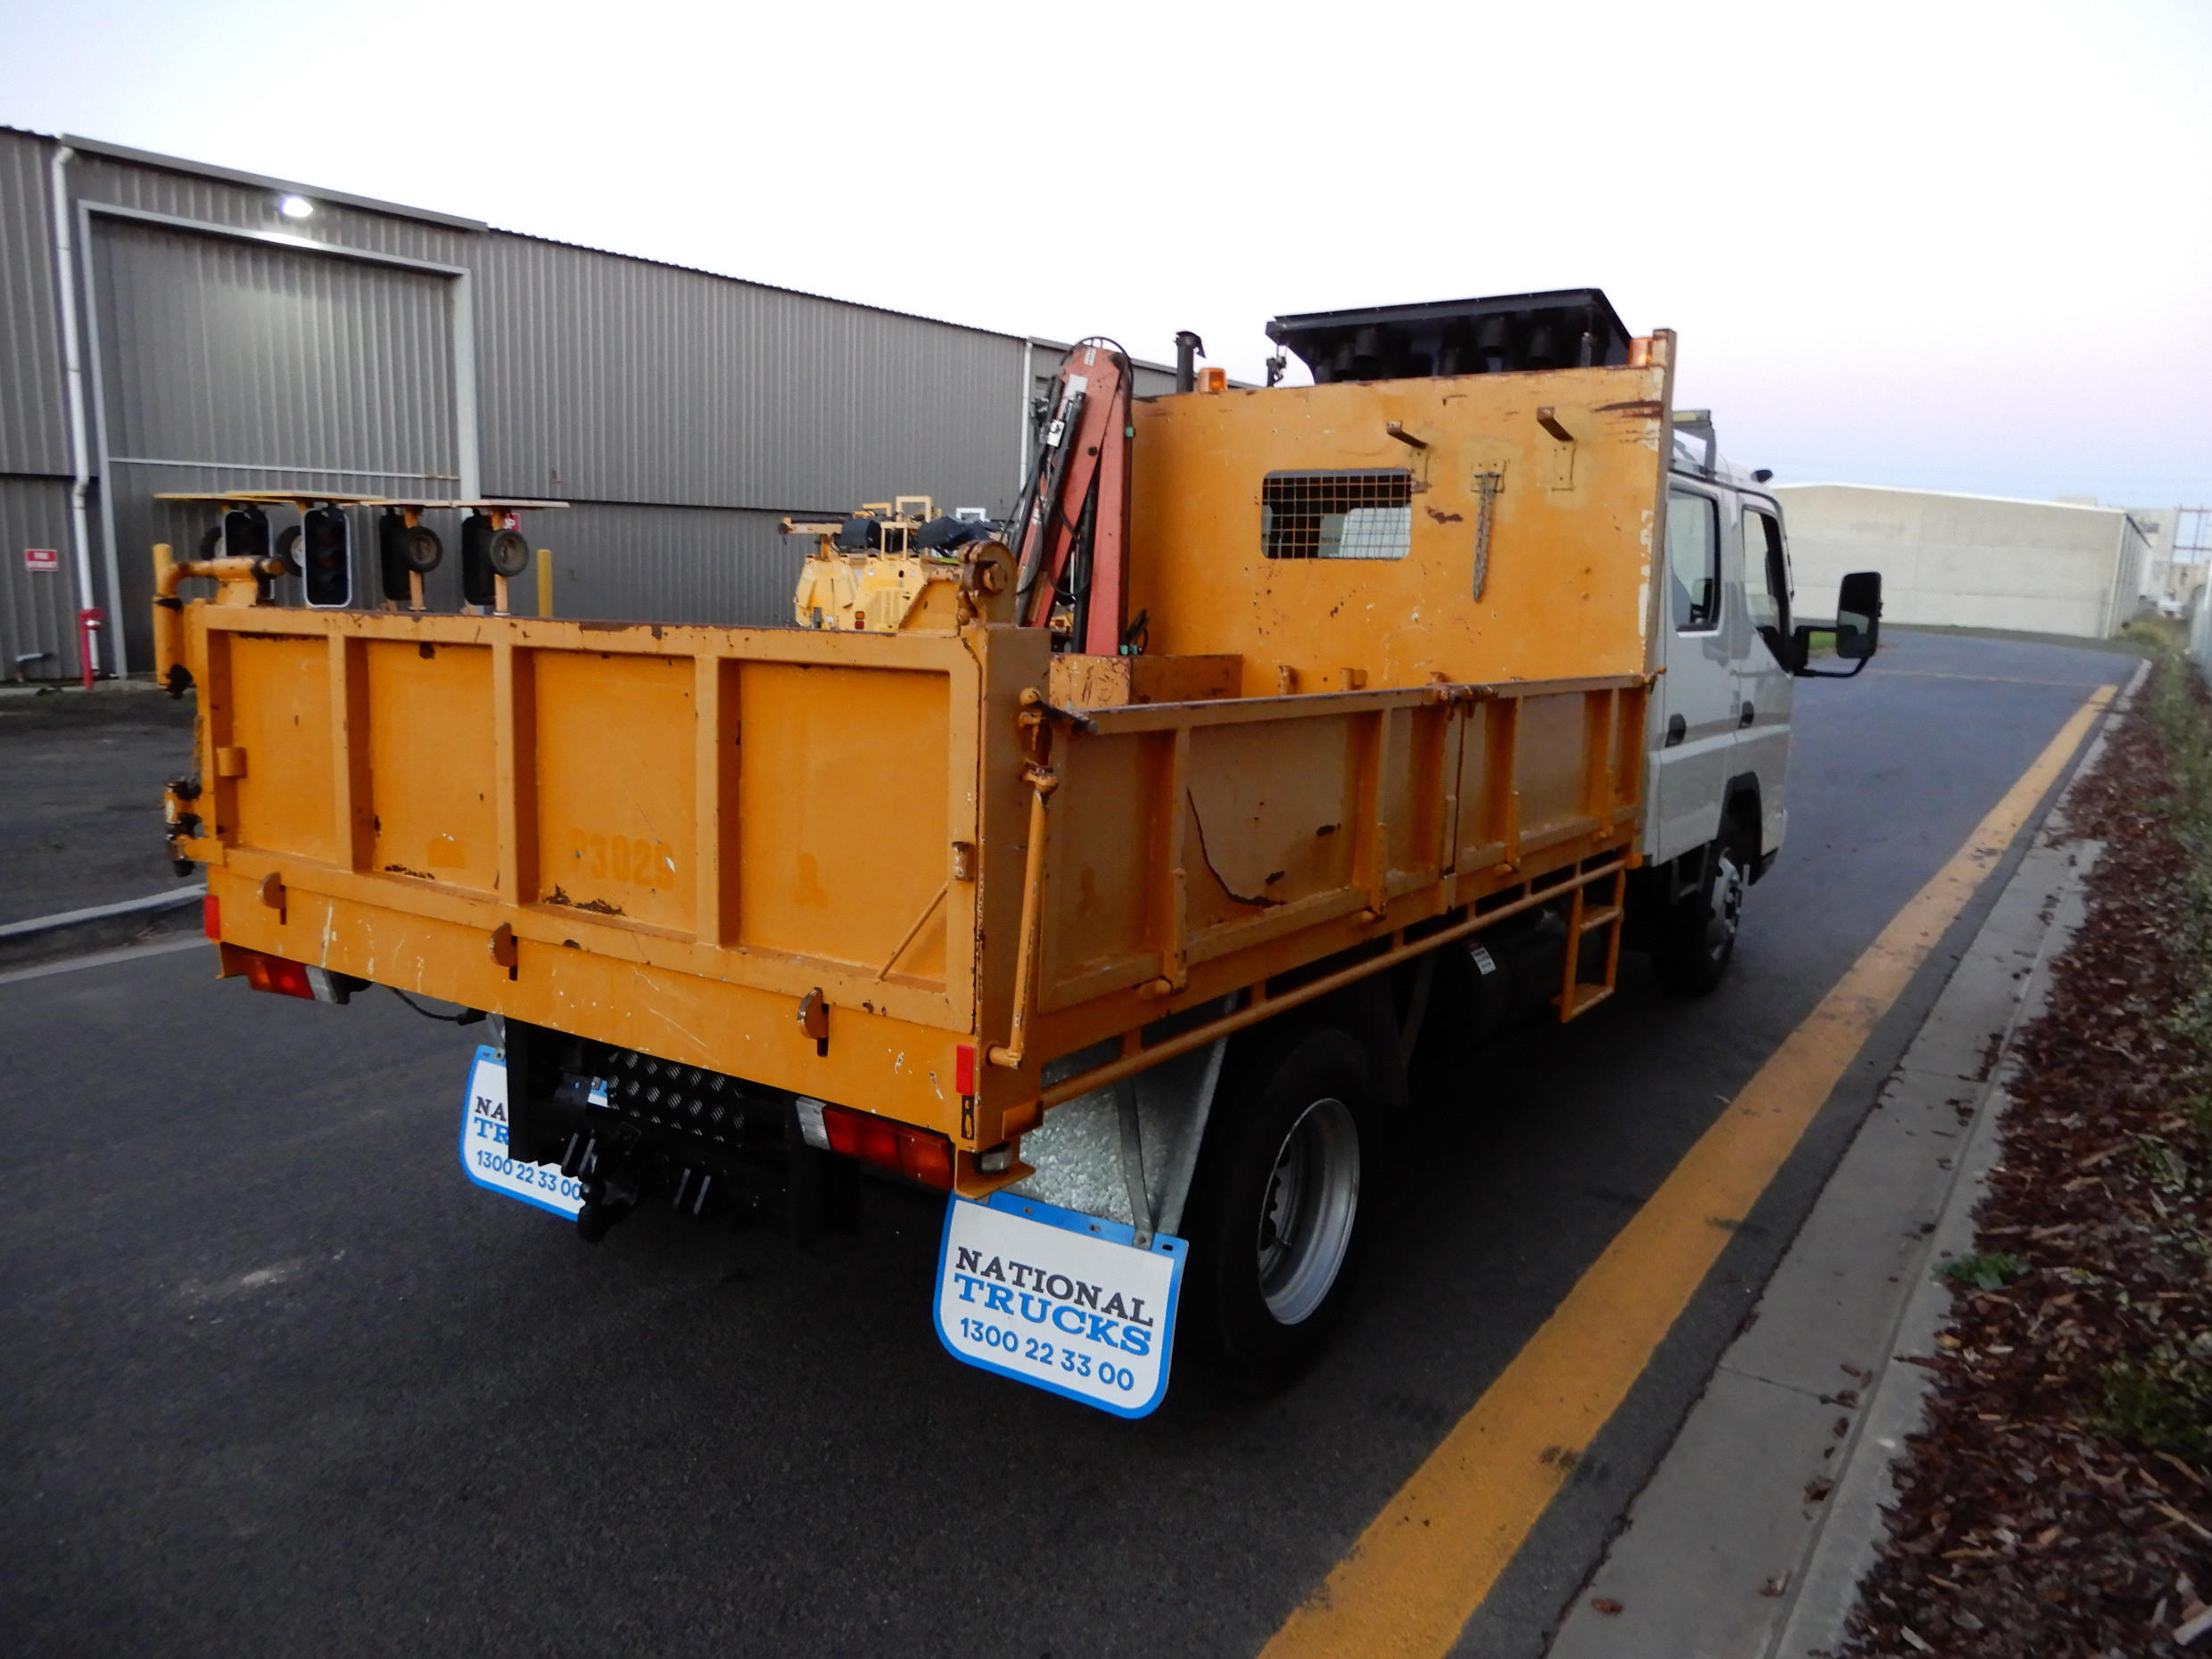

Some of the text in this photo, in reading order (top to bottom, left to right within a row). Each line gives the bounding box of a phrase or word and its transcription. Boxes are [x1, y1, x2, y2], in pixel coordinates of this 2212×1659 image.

[477, 1150, 582, 1200] 1300 22 33 00
[953, 1273, 1151, 1356] TRUCKS
[955, 1246, 1154, 1327] NATIONAL
[961, 1317, 1134, 1391] 1300 22 33 00
